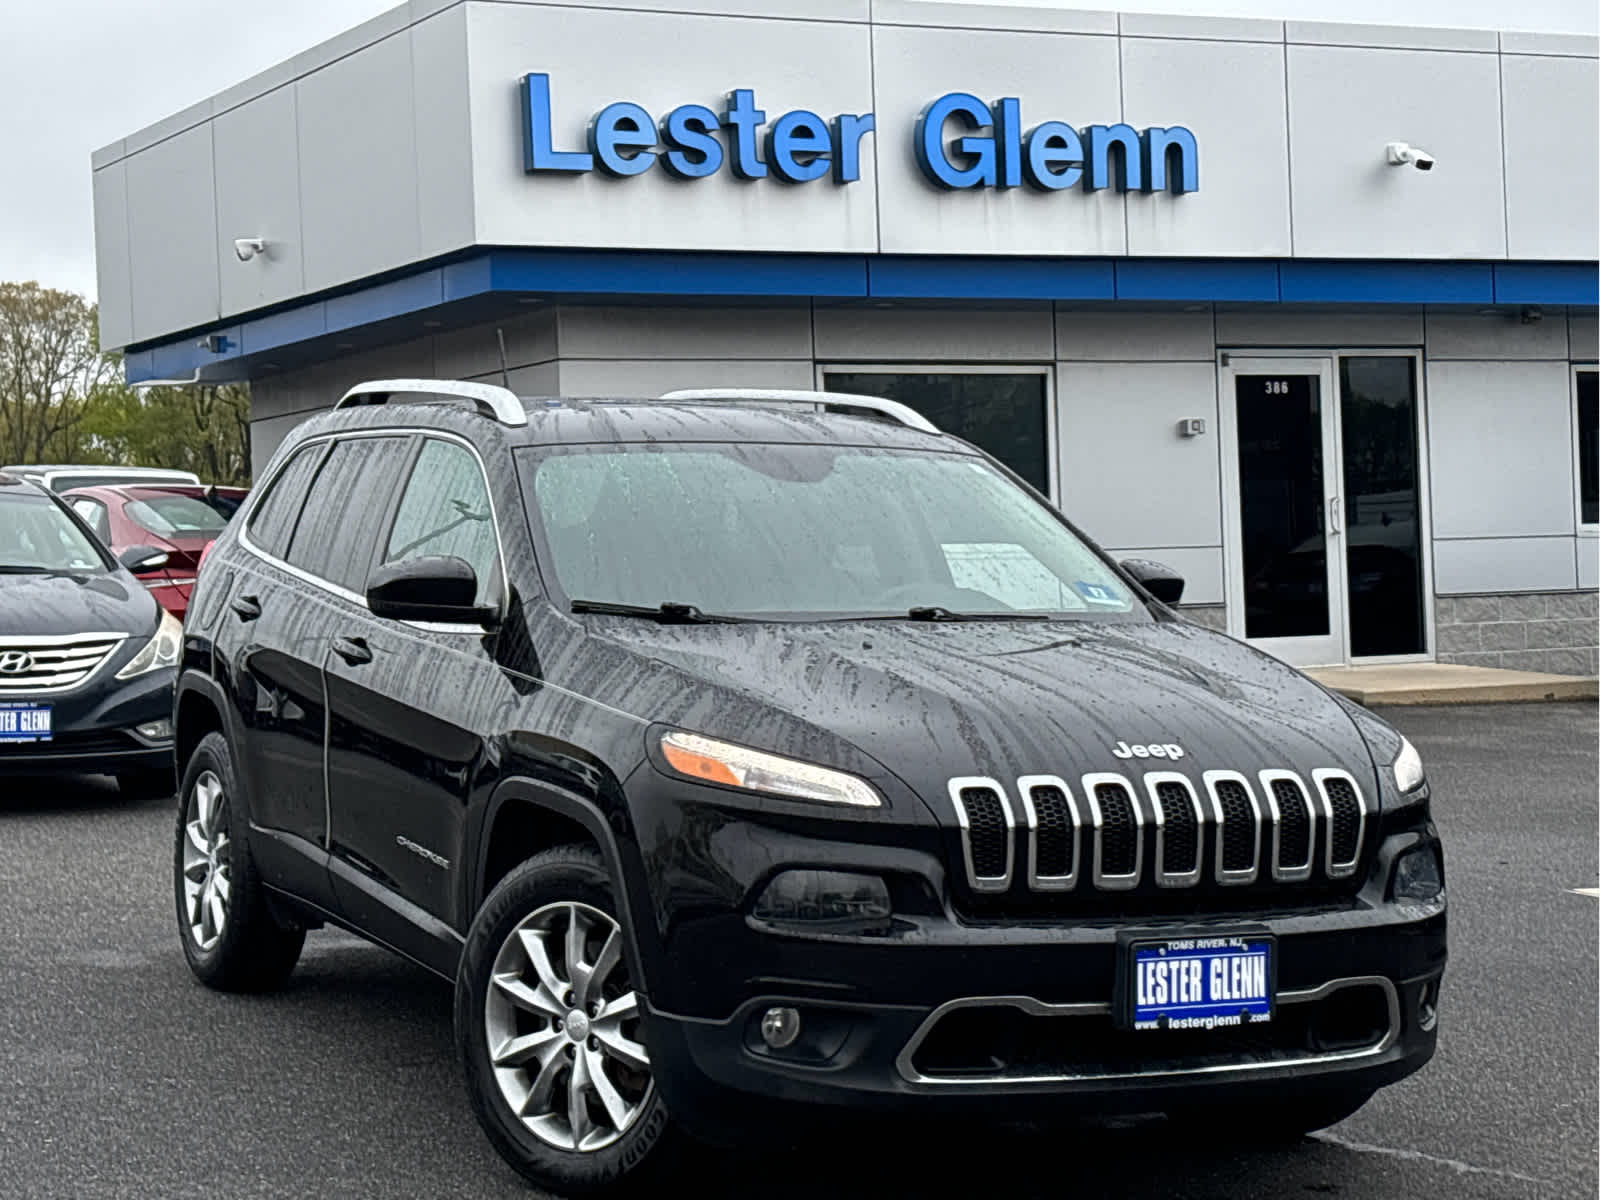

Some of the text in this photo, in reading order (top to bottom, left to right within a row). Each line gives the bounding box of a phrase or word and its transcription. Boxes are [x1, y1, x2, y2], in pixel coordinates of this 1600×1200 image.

[520, 72, 1199, 194] Lester Glenn
[1265, 381, 1289, 394] 386
[21, 711, 51, 731] GLENN
[1112, 741, 1184, 760] Jeep
[1167, 940, 1195, 951] TOMS
[1230, 936, 1243, 947] NJ
[1137, 955, 1266, 1006] LESTER GLENN
